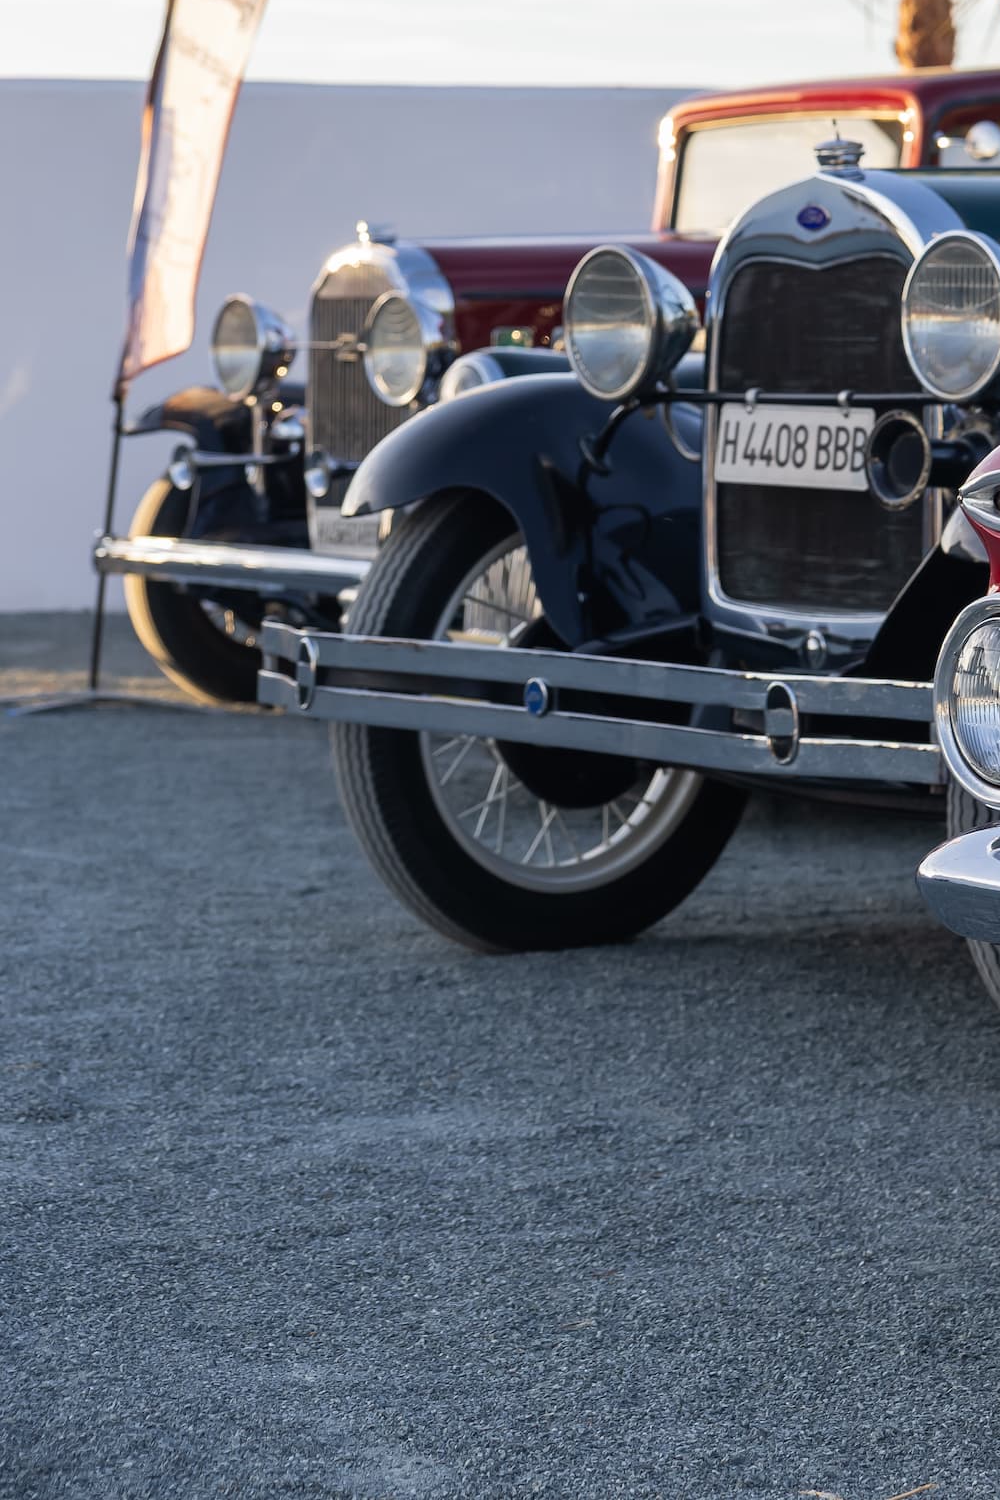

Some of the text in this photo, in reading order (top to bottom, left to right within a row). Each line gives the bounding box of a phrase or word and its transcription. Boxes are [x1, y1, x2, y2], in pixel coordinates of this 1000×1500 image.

[721, 420, 868, 472] H 4408 BBB
